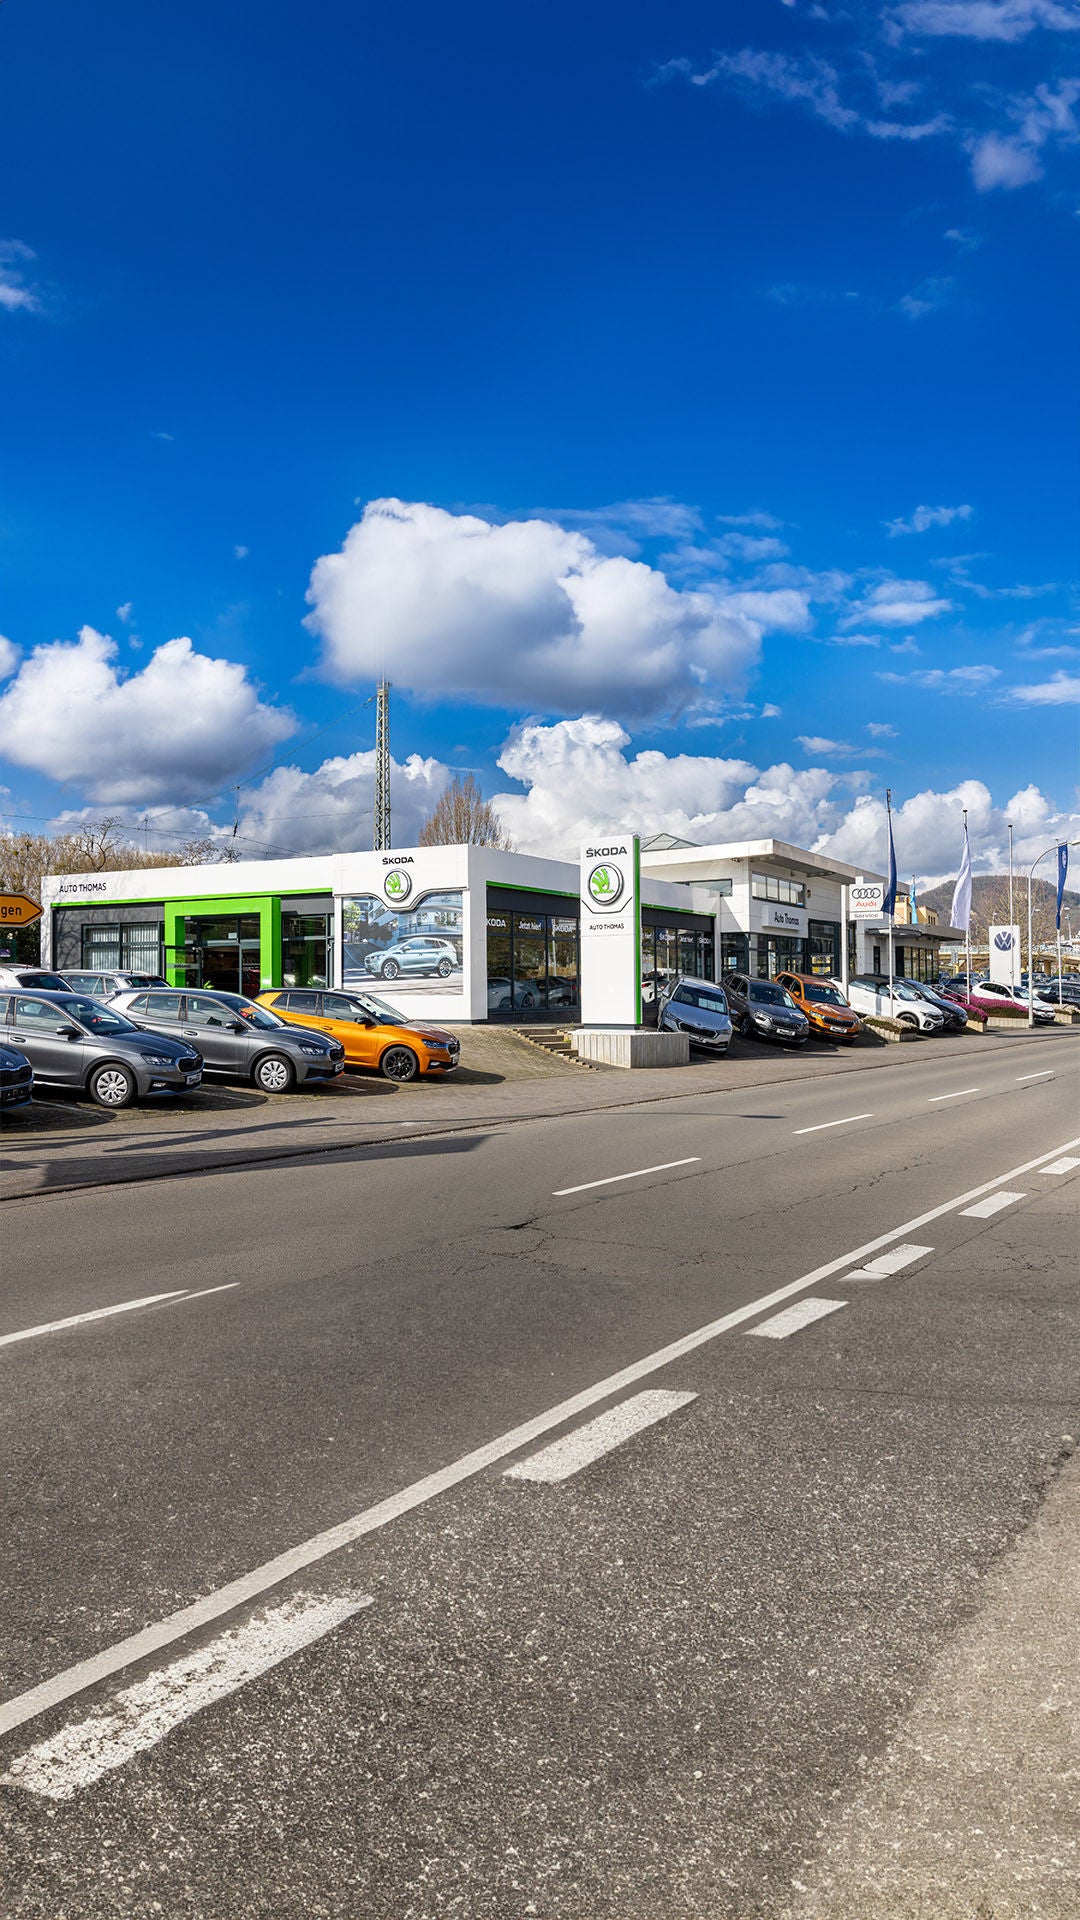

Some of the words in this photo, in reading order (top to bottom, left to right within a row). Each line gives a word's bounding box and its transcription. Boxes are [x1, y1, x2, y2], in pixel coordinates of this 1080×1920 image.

[586, 846, 628, 858] ŠKODA
[382, 856, 415, 865] ŠKODA
[59, 884, 78, 893] AUTO
[79, 882, 107, 892] THOMAS
[486, 918, 507, 928] KODA
